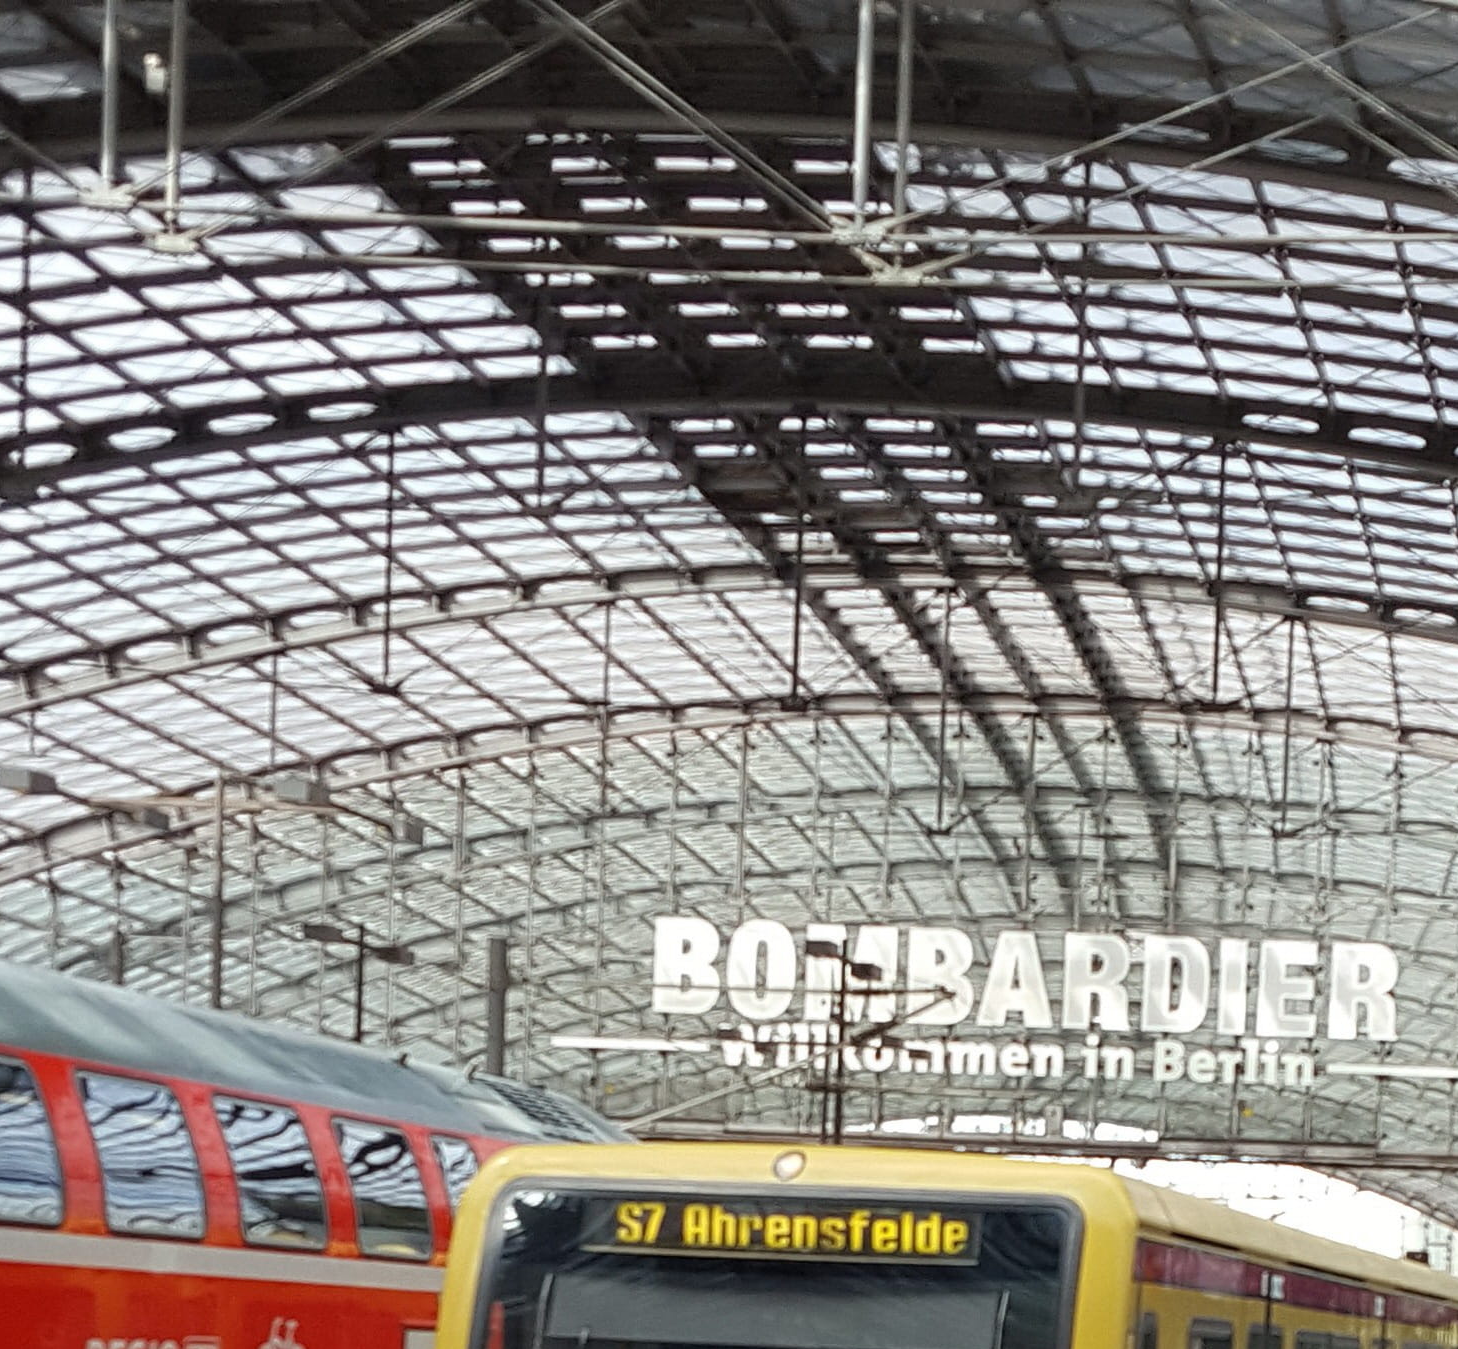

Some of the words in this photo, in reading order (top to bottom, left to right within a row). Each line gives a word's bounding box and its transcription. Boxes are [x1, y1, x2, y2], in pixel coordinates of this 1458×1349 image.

[652, 914, 1398, 1042] BOMBARDIER
[1080, 1033, 1135, 1081] in
[1153, 1038, 1315, 1087] Berlin
[615, 1202, 666, 1244] S7
[681, 1204, 970, 1255] Ahrensfelde
